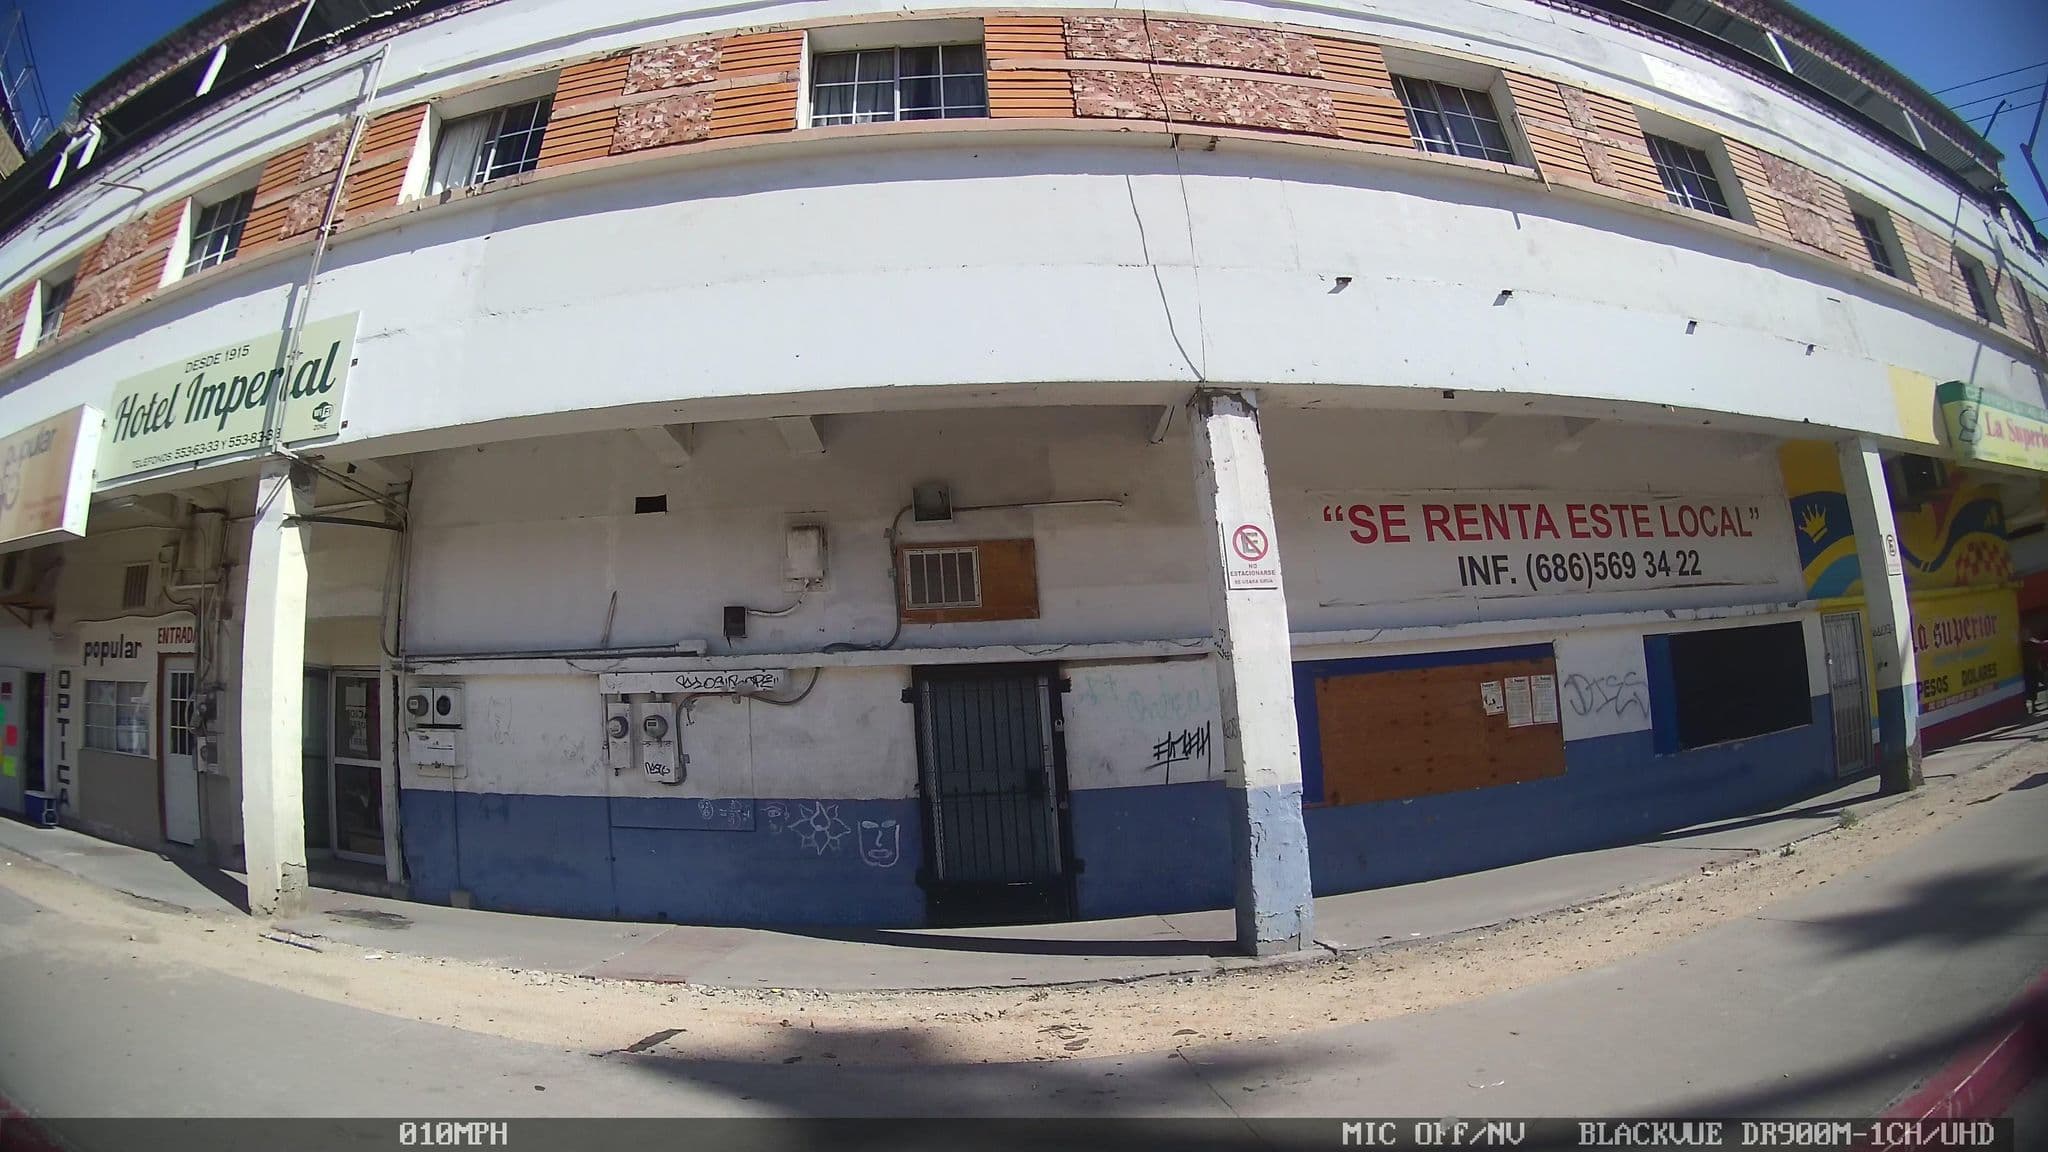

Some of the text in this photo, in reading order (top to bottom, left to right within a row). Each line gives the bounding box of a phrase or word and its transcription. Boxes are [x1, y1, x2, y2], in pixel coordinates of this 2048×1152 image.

[185, 345, 251, 374] DESDE 1915
[113, 339, 342, 443] Hotel Imperal
[1985, 412, 2004, 439] La
[1422, 503, 1561, 542] RENTA
[1566, 503, 1654, 539] ESTE
[1230, 569, 1276, 577] ESTACIONARSE
[1458, 550, 1702, 592] INF. (686)569 34 22
[83, 634, 143, 667] popular
[1933, 615, 1998, 650] superior
[1916, 674, 1949, 701] PESOS
[1961, 662, 1998, 687] DOLARES
[56, 669, 71, 807] OPTICA
